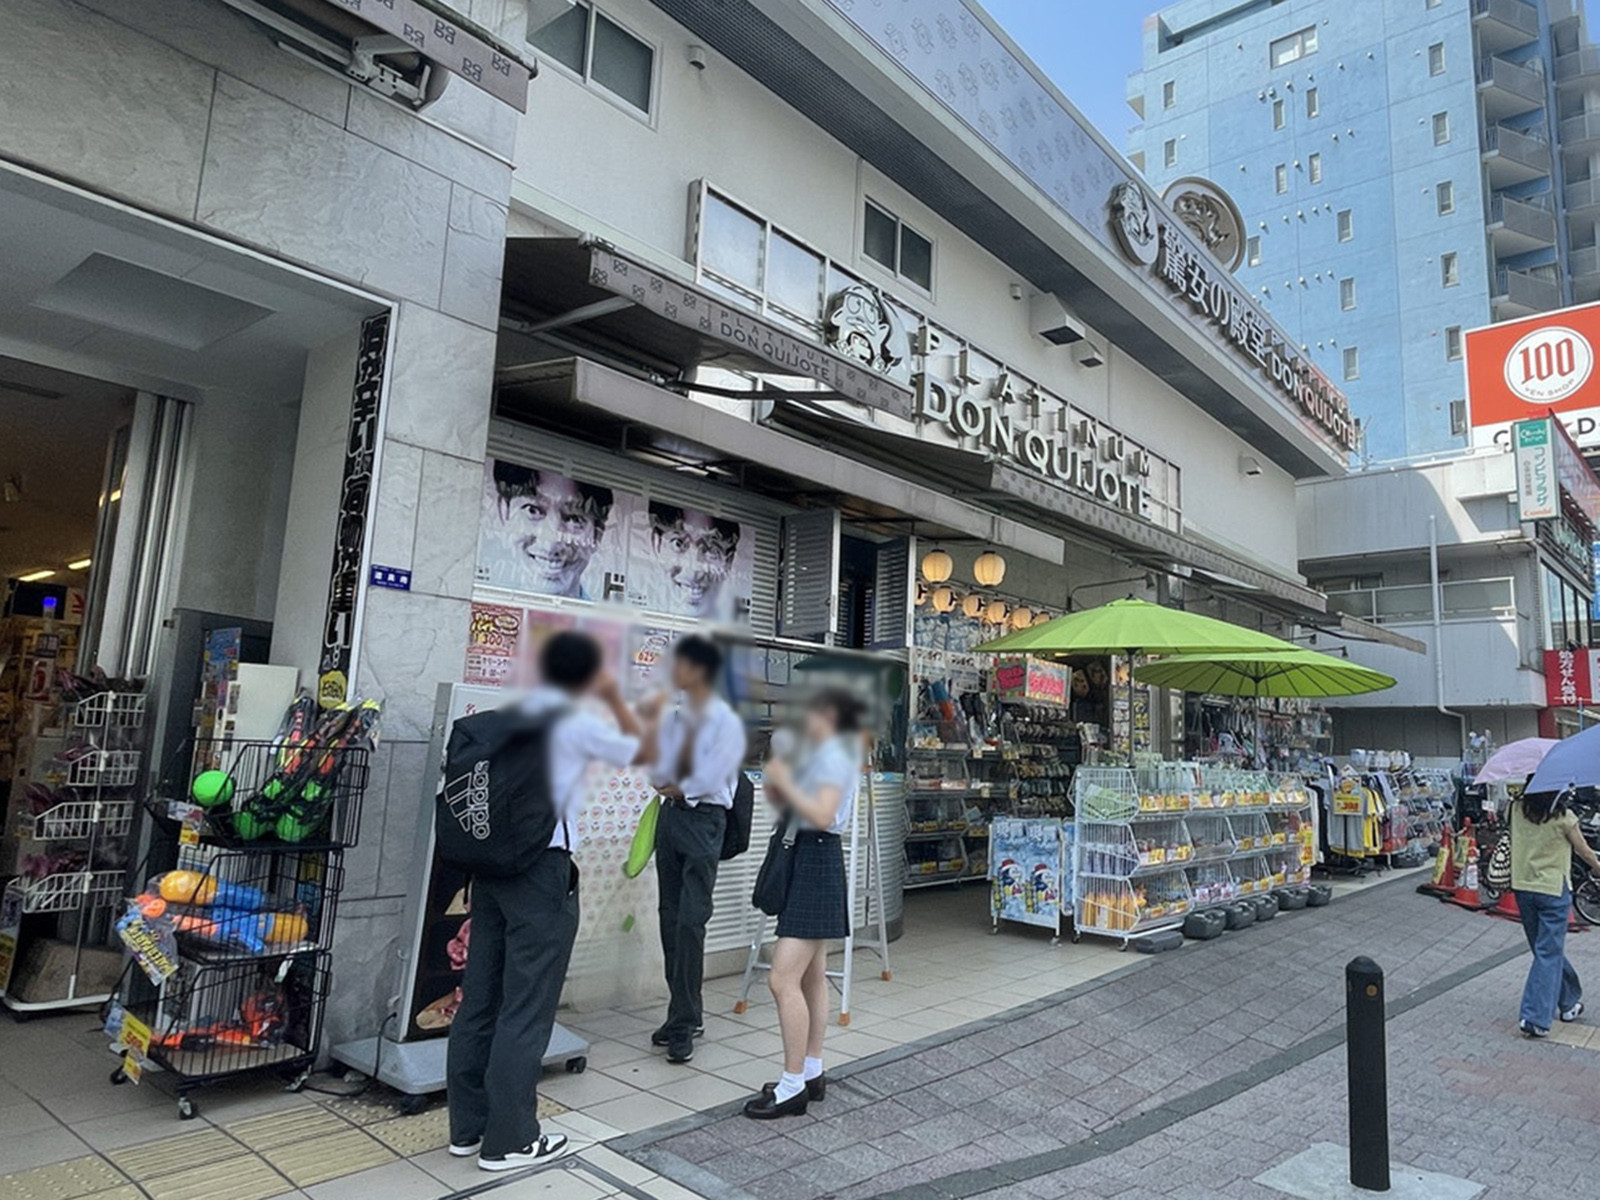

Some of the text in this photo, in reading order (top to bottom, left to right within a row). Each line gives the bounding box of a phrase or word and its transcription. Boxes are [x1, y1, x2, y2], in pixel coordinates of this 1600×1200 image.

[1162, 221, 1268, 367] 驚安の殿堂
[719, 310, 830, 366] PLATINUM
[720, 323, 830, 382] DON QUIJOTE
[1519, 338, 1576, 384] 100
[919, 324, 1152, 477] PLATINUM
[1272, 352, 1304, 402] DON
[1304, 387, 1355, 450] QUIJOTE
[1525, 379, 1576, 397] YEN SHOP
[915, 373, 1153, 522] DON QUIJOTE
[1558, 650, 1577, 704] 処方せん受付
[472, 759, 491, 840] adidas
